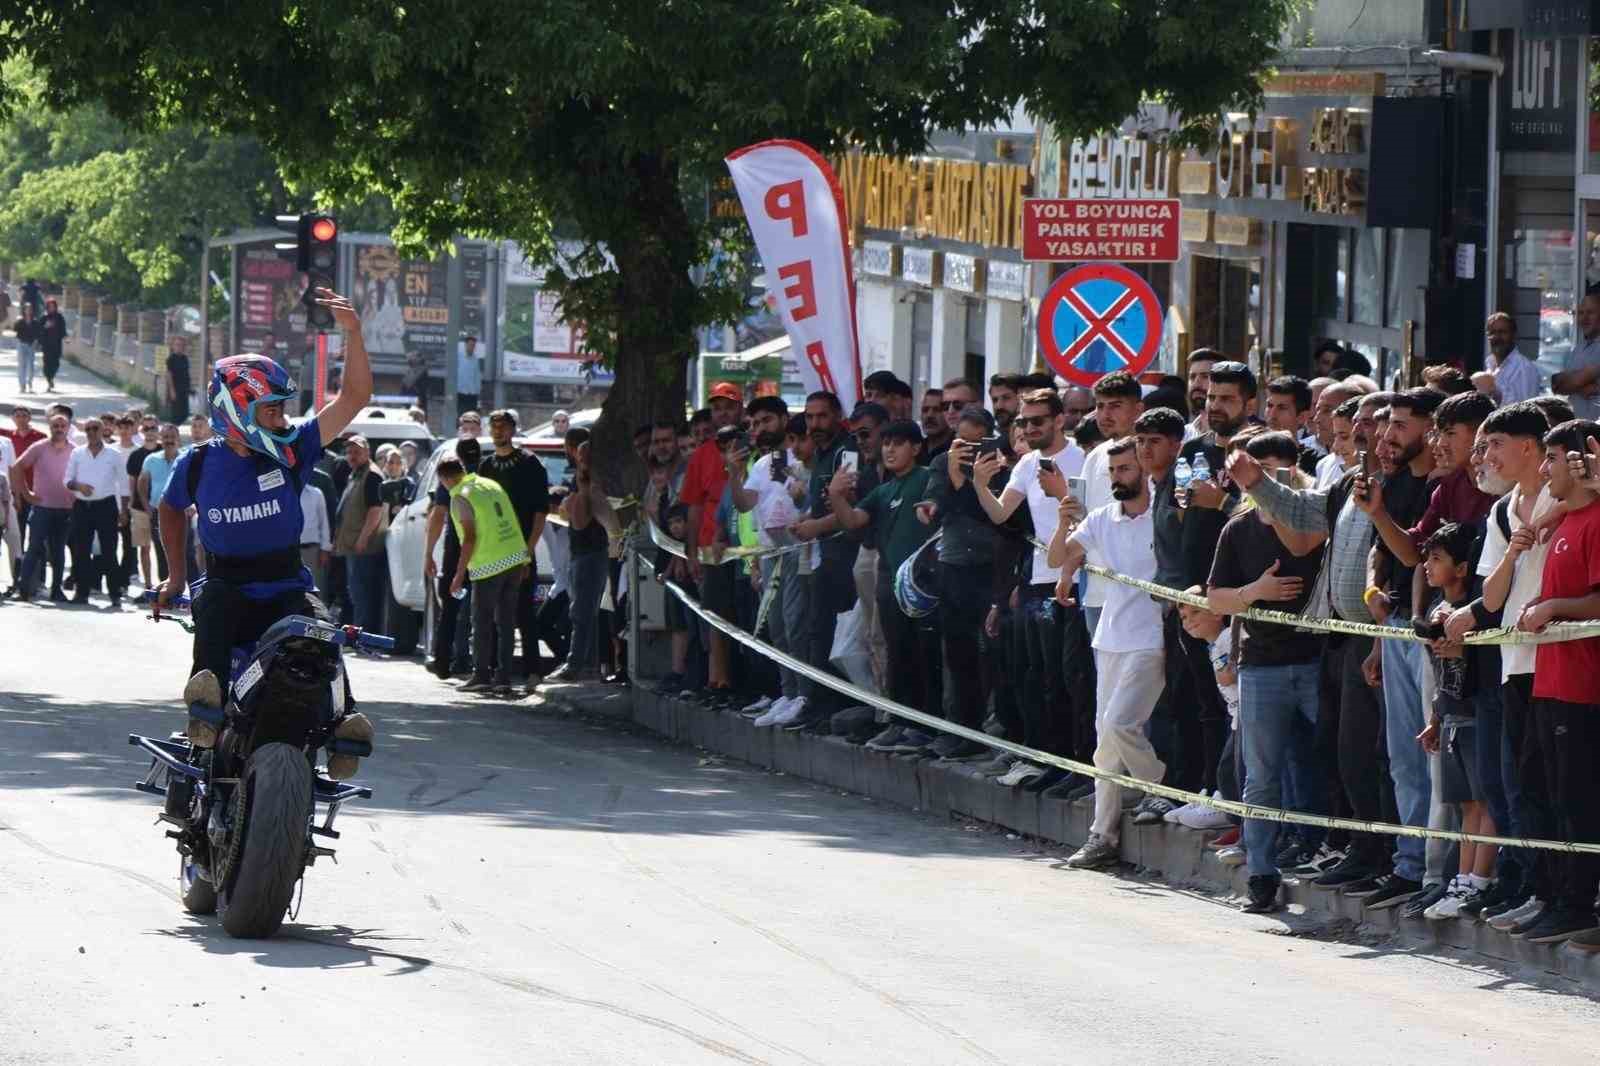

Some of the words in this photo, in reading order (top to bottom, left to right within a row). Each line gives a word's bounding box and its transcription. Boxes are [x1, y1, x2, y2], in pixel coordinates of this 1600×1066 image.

[1031, 204, 1070, 219] YOL
[1076, 204, 1172, 219] BOYUNCA
[1038, 223, 1091, 238] PARK
[1096, 223, 1165, 238] ETMEK
[1046, 242, 1145, 256] YASAKTIR
[1150, 242, 1157, 256] !
[405, 273, 428, 295] EN
[223, 499, 281, 523] YAMAHA
